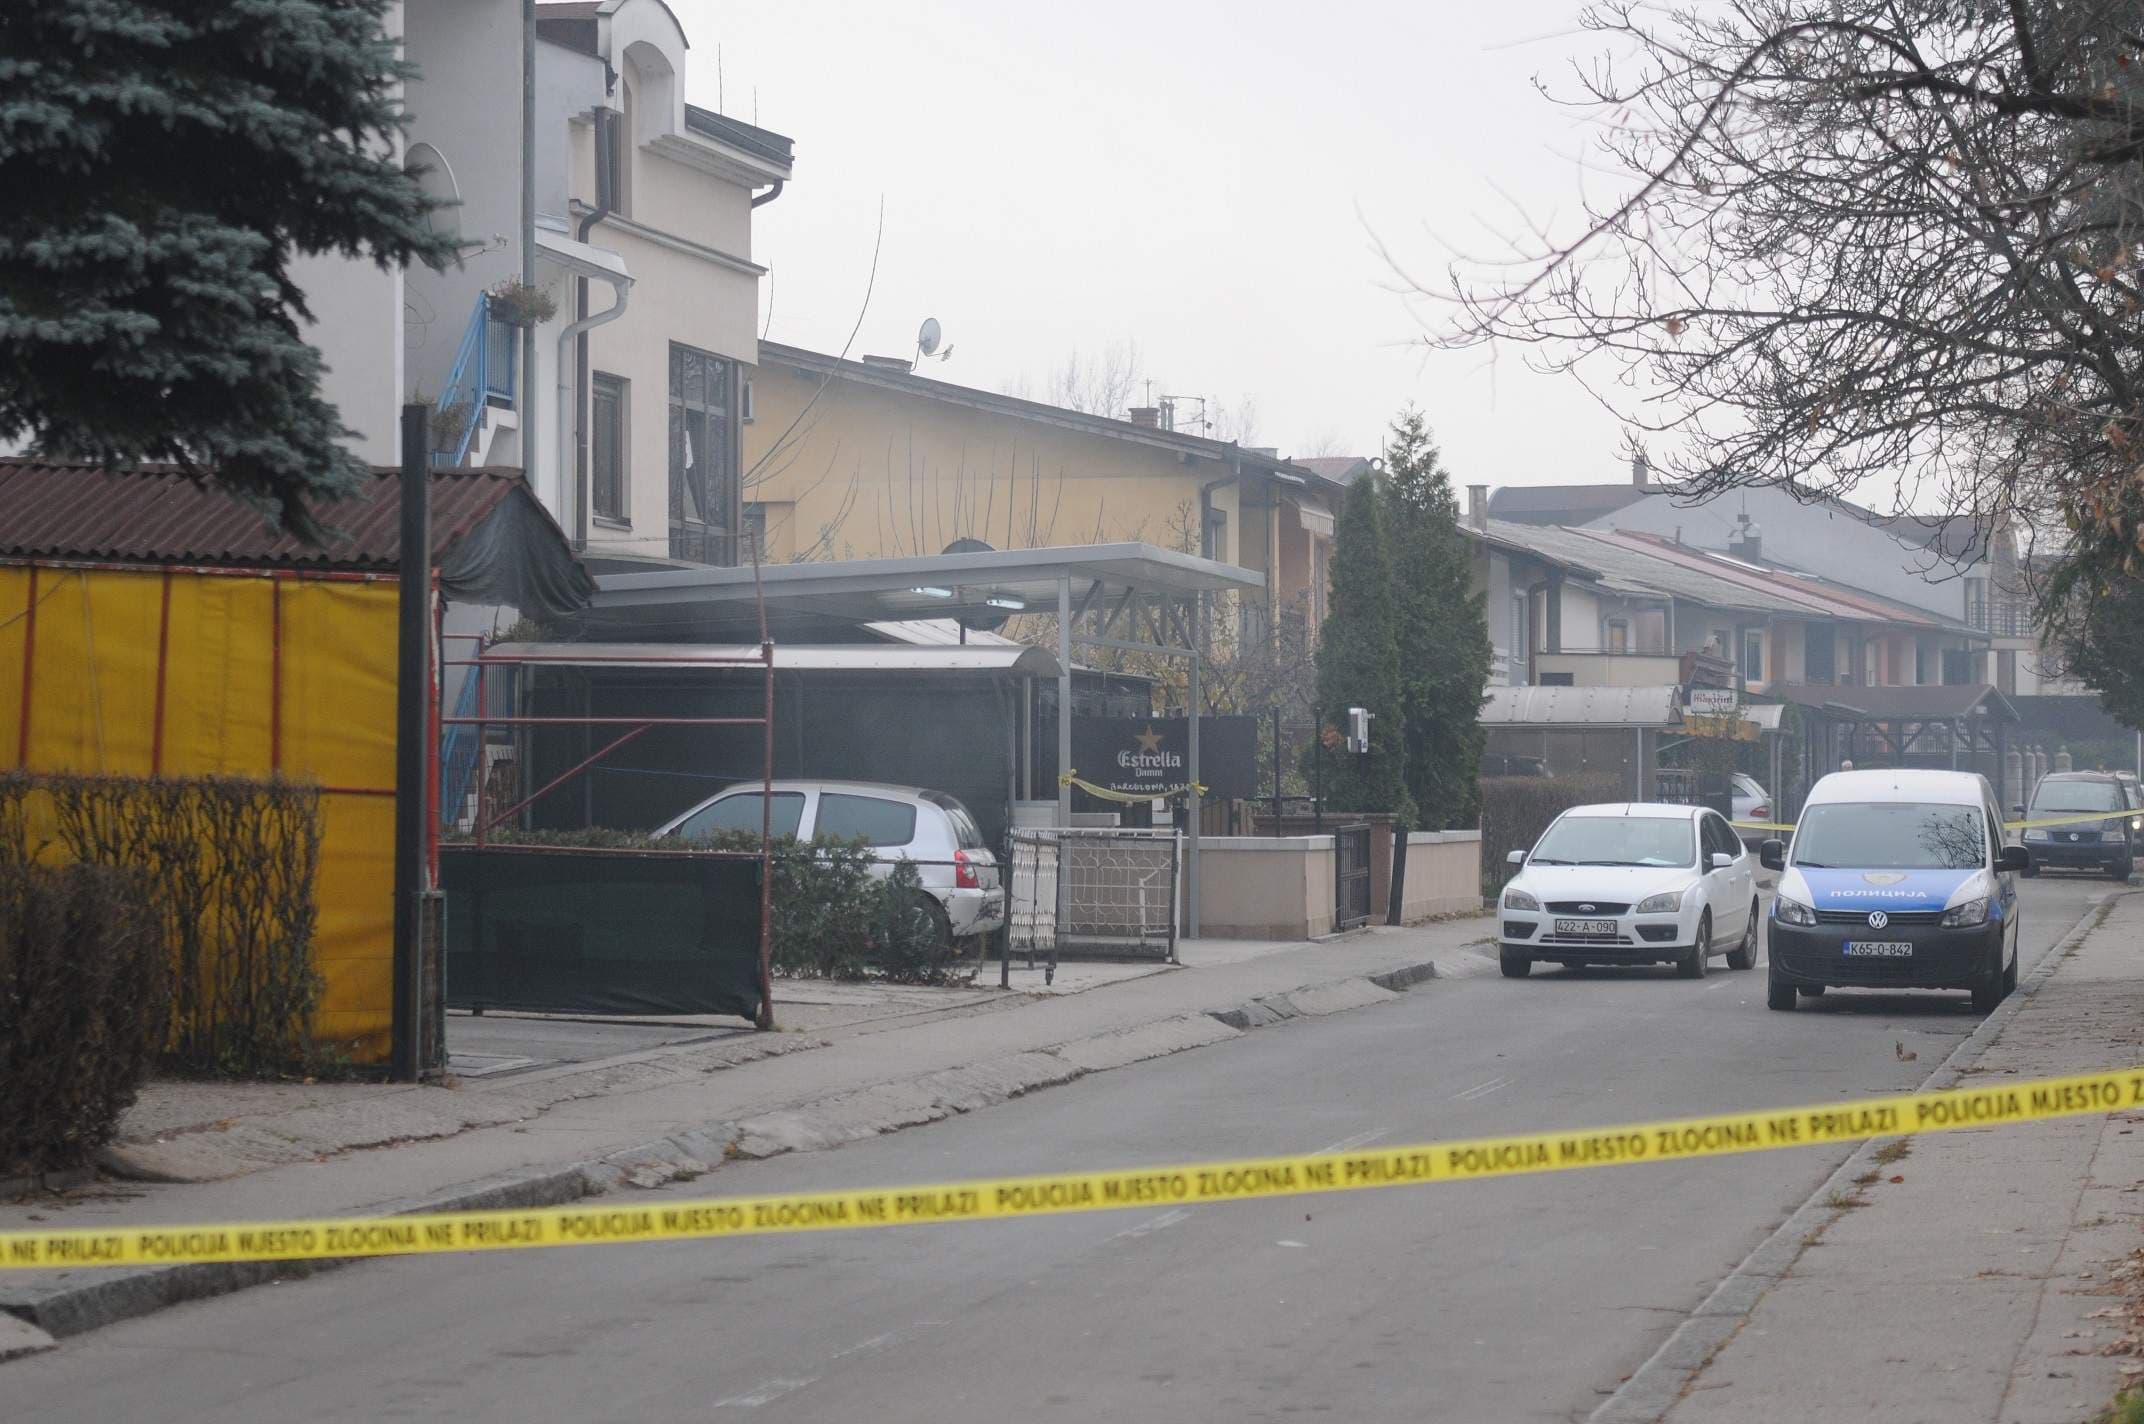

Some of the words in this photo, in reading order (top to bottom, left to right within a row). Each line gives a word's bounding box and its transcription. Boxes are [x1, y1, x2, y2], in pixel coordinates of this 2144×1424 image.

[1117, 750, 1181, 768] Estrella
[1135, 768, 1163, 777] Damm
[1830, 890, 1927, 898] ПОЛИЦИЈА
[1557, 921, 1615, 933] 422-A-090
[13, 1239, 37, 1263] NE
[48, 1236, 121, 1261] PRILAZI
[138, 1232, 228, 1257] POLICIJA
[238, 1229, 318, 1253] MJESTO
[326, 1221, 416, 1251] ZLOCINA
[427, 1222, 451, 1246] NE
[461, 1218, 541, 1244] PRILAZI
[558, 1212, 652, 1238] POLICIJA
[663, 1207, 743, 1234] MJESTO
[754, 1201, 846, 1228] ZLOCINA
[857, 1197, 885, 1221] NE
[895, 1191, 979, 1217] PRILAZI
[996, 1182, 1093, 1210] POLICIJA
[1103, 1174, 1188, 1202] MJESTO
[1197, 1167, 1296, 1196] ZLOCINA
[1305, 1162, 1335, 1186] NE
[1344, 1153, 1432, 1182] PRILAZI
[1448, 1143, 1550, 1173] POLICIJA
[1559, 1134, 1647, 1162] MJESTO
[1657, 1123, 1758, 1155] ZLOCINA
[1769, 1118, 1800, 1143] NE
[1810, 1107, 1898, 1137] PRILAZI
[1917, 1092, 2022, 1126] POLICIJA
[2030, 1081, 2121, 1115] MJESTO
